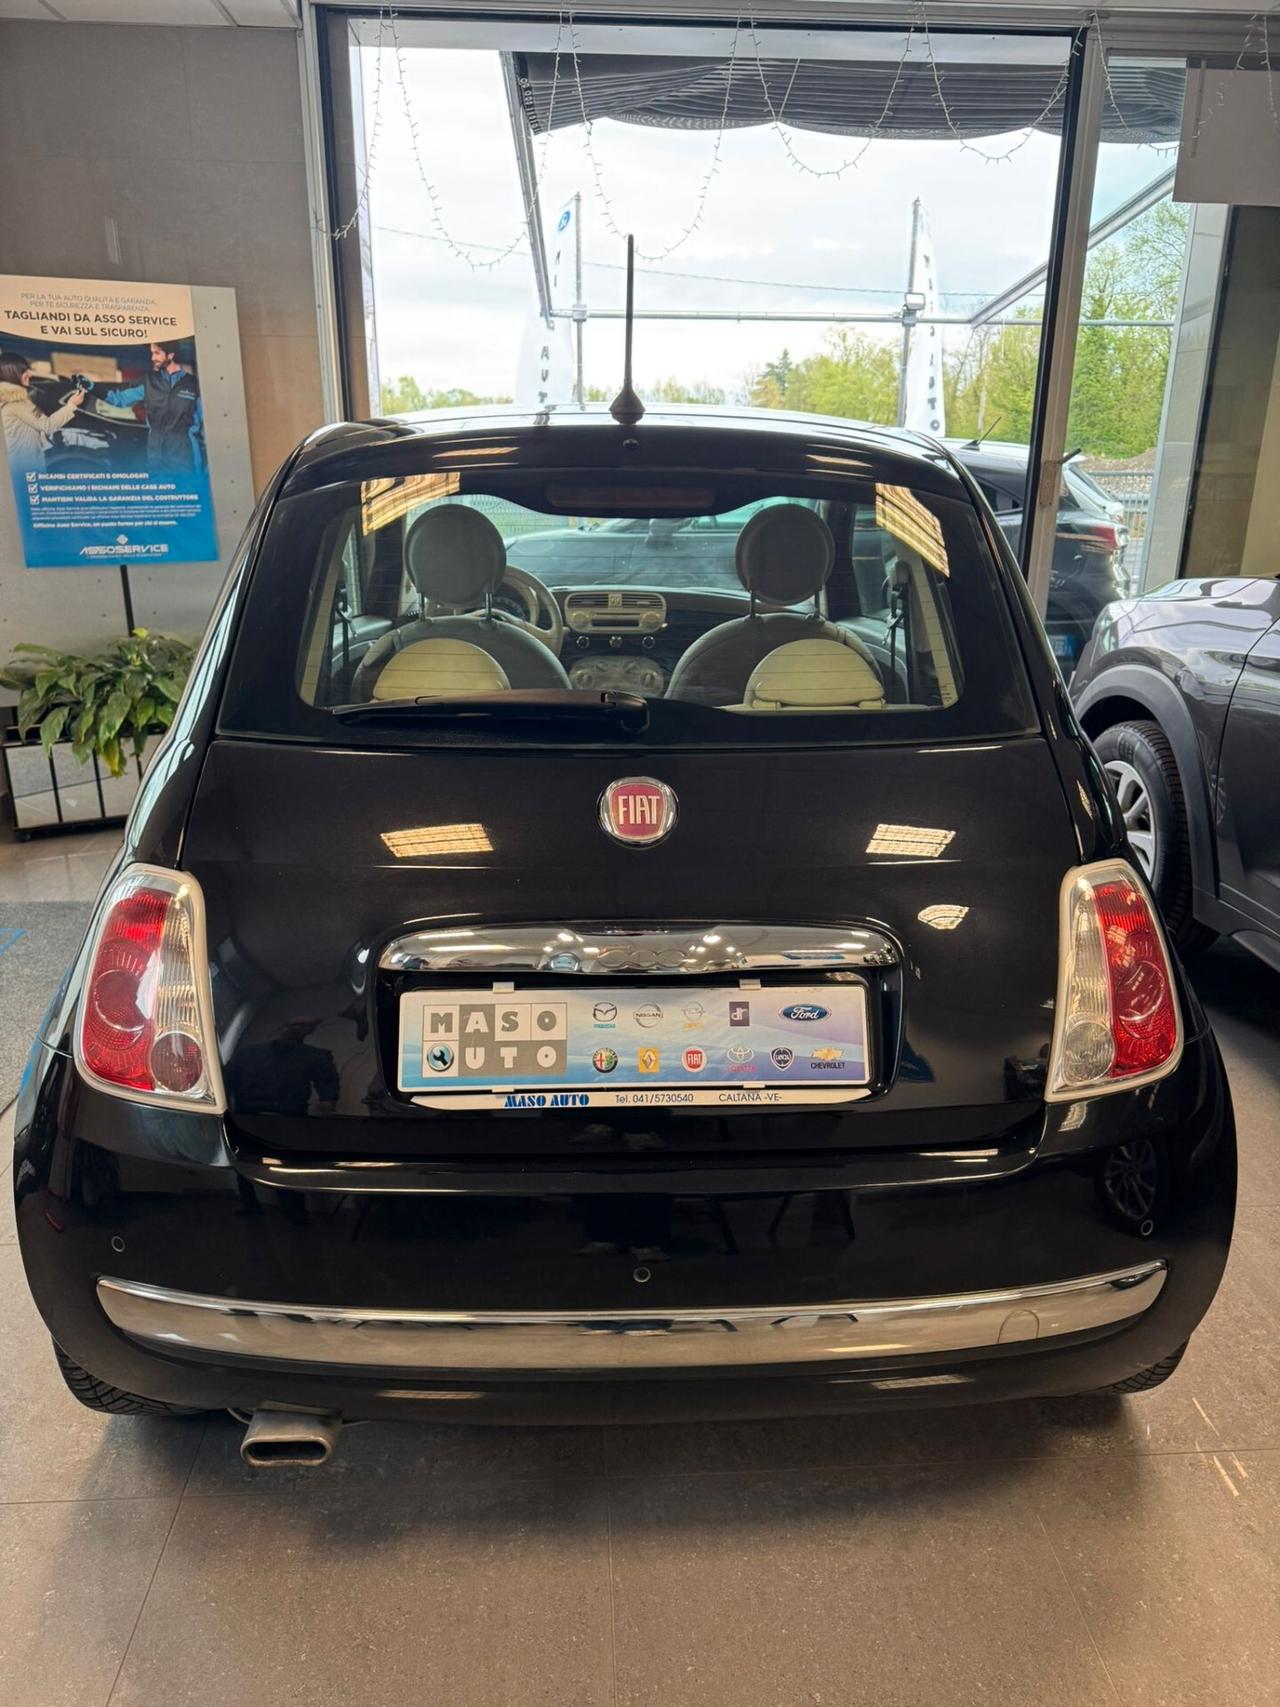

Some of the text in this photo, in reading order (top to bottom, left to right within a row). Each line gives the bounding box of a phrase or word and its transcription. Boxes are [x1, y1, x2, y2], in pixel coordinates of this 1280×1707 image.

[5, 310, 177, 326] TAGLIANDI DA ASSO SERVICE
[40, 325, 148, 338] E VAI SUL SICURO!
[618, 795, 660, 825] FIAT
[731, 1007, 748, 1020] dr
[790, 1006, 820, 1019] Ford
[430, 1010, 557, 1033] MASO
[687, 1053, 703, 1065] FIAT
[504, 1095, 546, 1107] MASO
[550, 1094, 590, 1106] AUTO
[615, 1094, 631, 1103] Tel.
[633, 1093, 693, 1104] 041/5730540
[763, 1093, 782, 1101] -VE-
